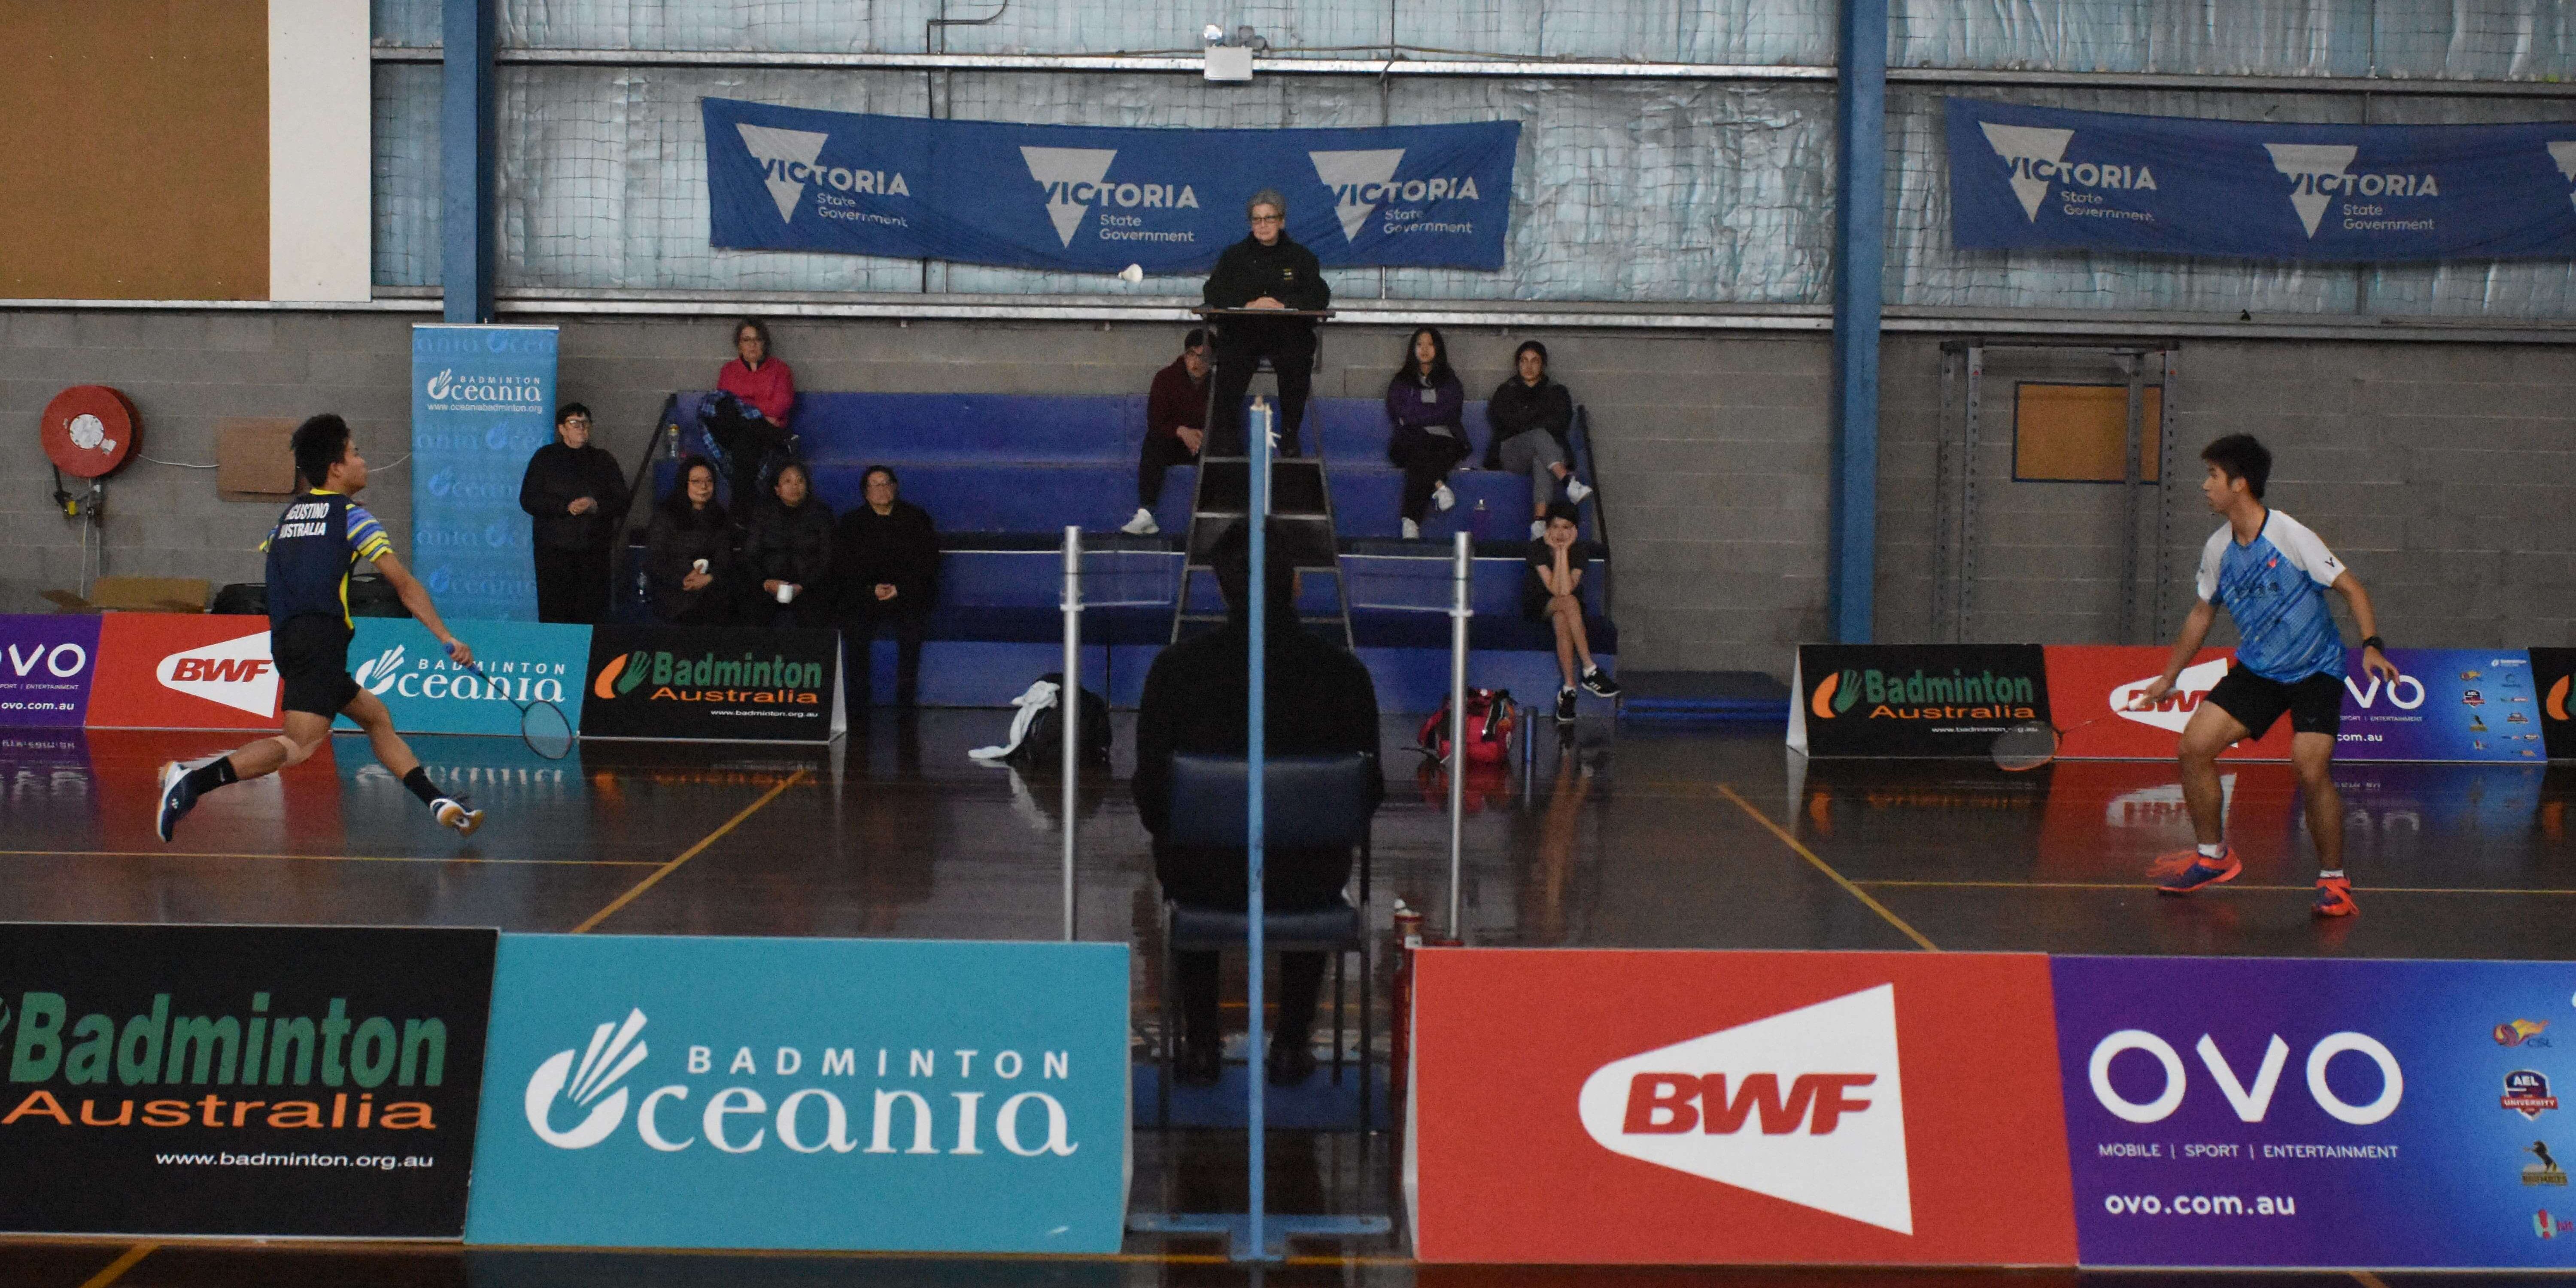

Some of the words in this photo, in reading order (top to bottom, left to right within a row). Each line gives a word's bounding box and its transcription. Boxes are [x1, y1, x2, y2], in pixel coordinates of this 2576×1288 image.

[754, 157, 910, 196] VICTORIA
[1999, 155, 2157, 190] VICTORIA
[1035, 180, 1199, 208] VICTORIA
[1325, 176, 1479, 206] VICTORIA
[2278, 171, 2439, 196] VICTORIA
[817, 193, 856, 207] State
[2061, 191, 2103, 204] State
[818, 207, 908, 228] Government
[1100, 214, 1142, 227] State
[1385, 209, 1423, 220] State
[2343, 204, 2383, 216] State
[1100, 228, 1194, 242] Government
[1384, 222, 1473, 234] Government
[2343, 219, 2434, 231] Government
[428, 404, 543, 414] www.oceaniabadminton.org
[0, 643, 85, 677] VO
[171, 658, 272, 682] BWF
[419, 659, 565, 674] BADMINTON
[652, 651, 822, 688] Badminton
[650, 687, 818, 704] Australia
[1865, 668, 2034, 704] Badminton
[2345, 675, 2425, 709] VO
[710, 709, 818, 718] www.badminton.org.au
[1869, 705, 2035, 719] Australia
[9, 991, 447, 1088] Badminton
[688, 1045, 1069, 1079] BADMINTON
[2089, 1029, 2403, 1125] OVO
[1, 1090, 436, 1130] Australia
[1622, 1072, 1877, 1136] BWF
[155, 1151, 433, 1170] www.badminton.org.au
[2099, 1144, 2161, 1157] MOBILE
[2185, 1145, 2239, 1157] SPORT
[2264, 1145, 2398, 1158] ENTERTAINMENT
[2105, 1194, 2296, 1216] ovo.com.au
